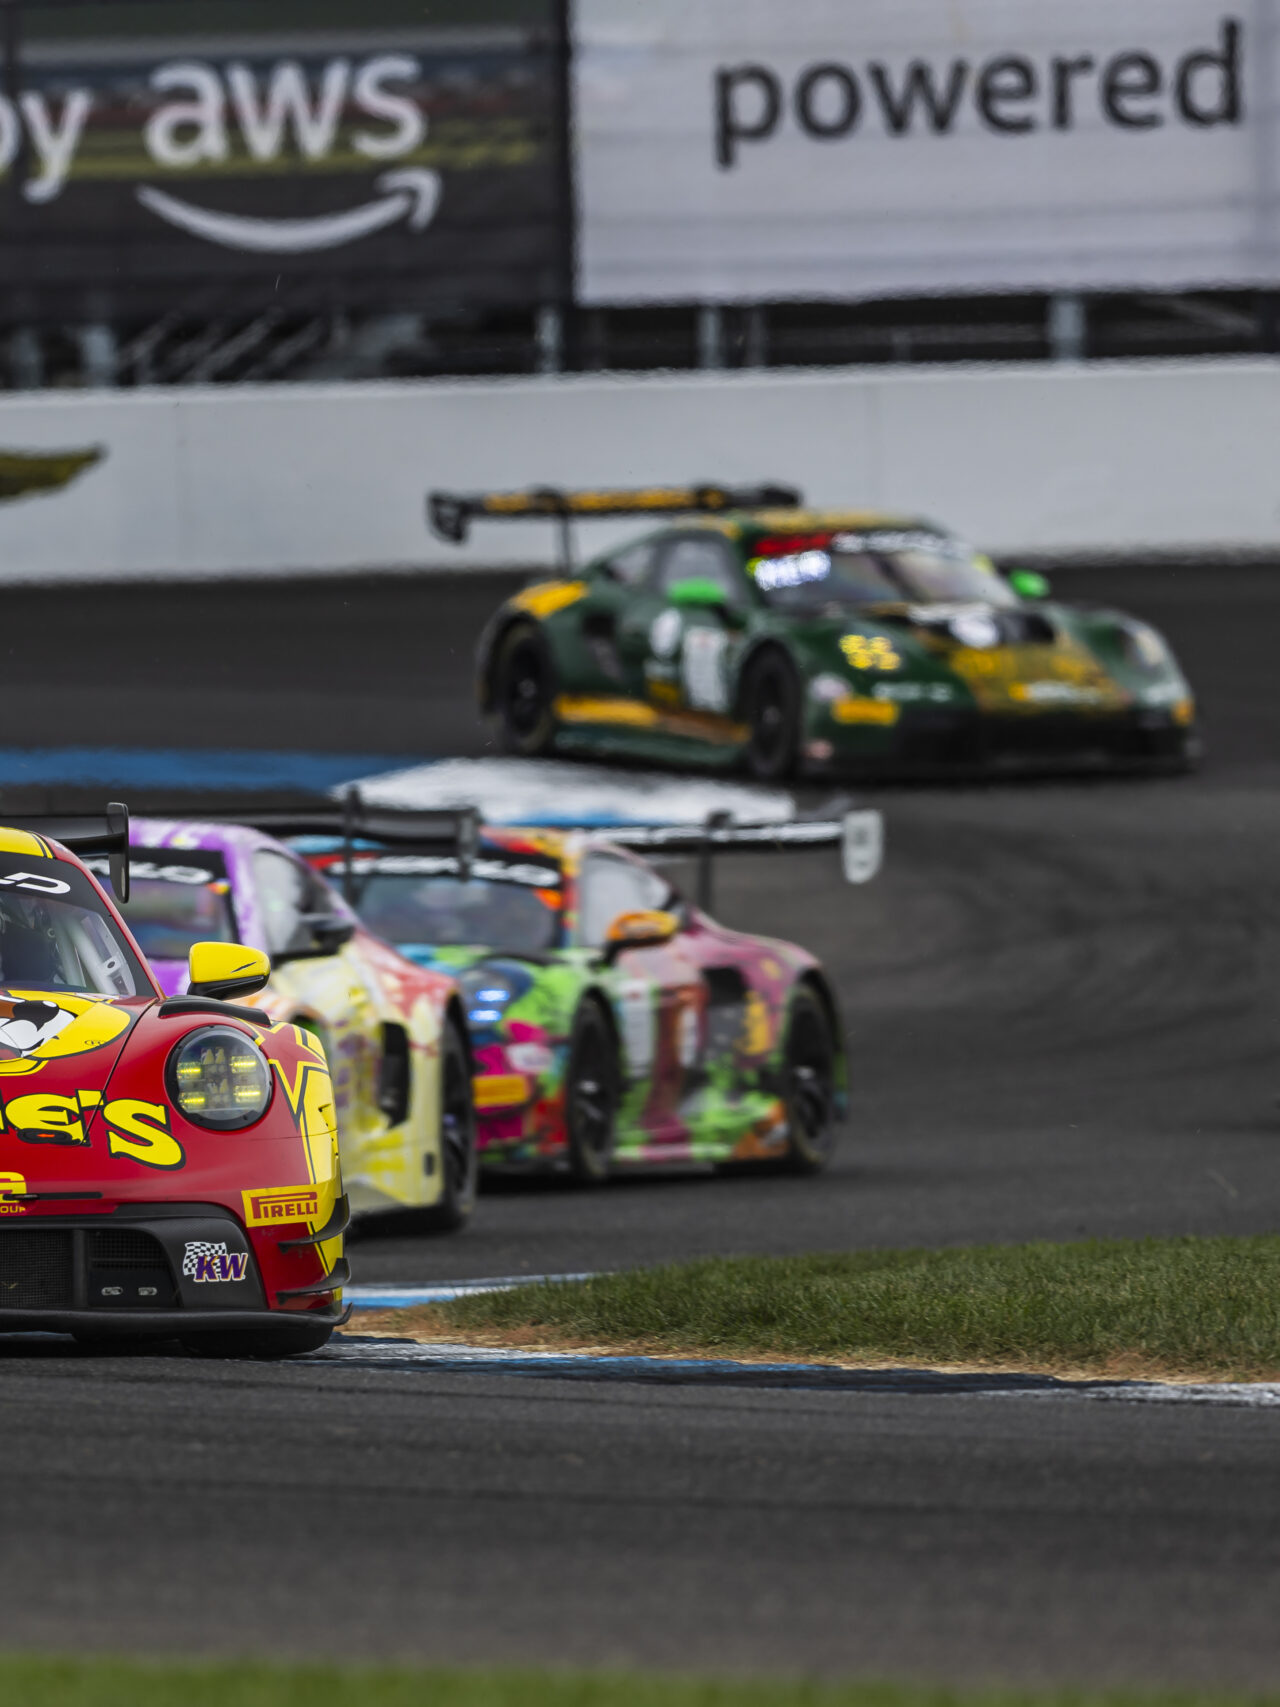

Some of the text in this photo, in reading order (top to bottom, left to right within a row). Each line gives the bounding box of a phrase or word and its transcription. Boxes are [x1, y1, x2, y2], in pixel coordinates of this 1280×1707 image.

[144, 54, 426, 168] aws
[712, 18, 1245, 171] powered
[250, 1191, 318, 1220] PIRELLI
[193, 1252, 249, 1282] KW
